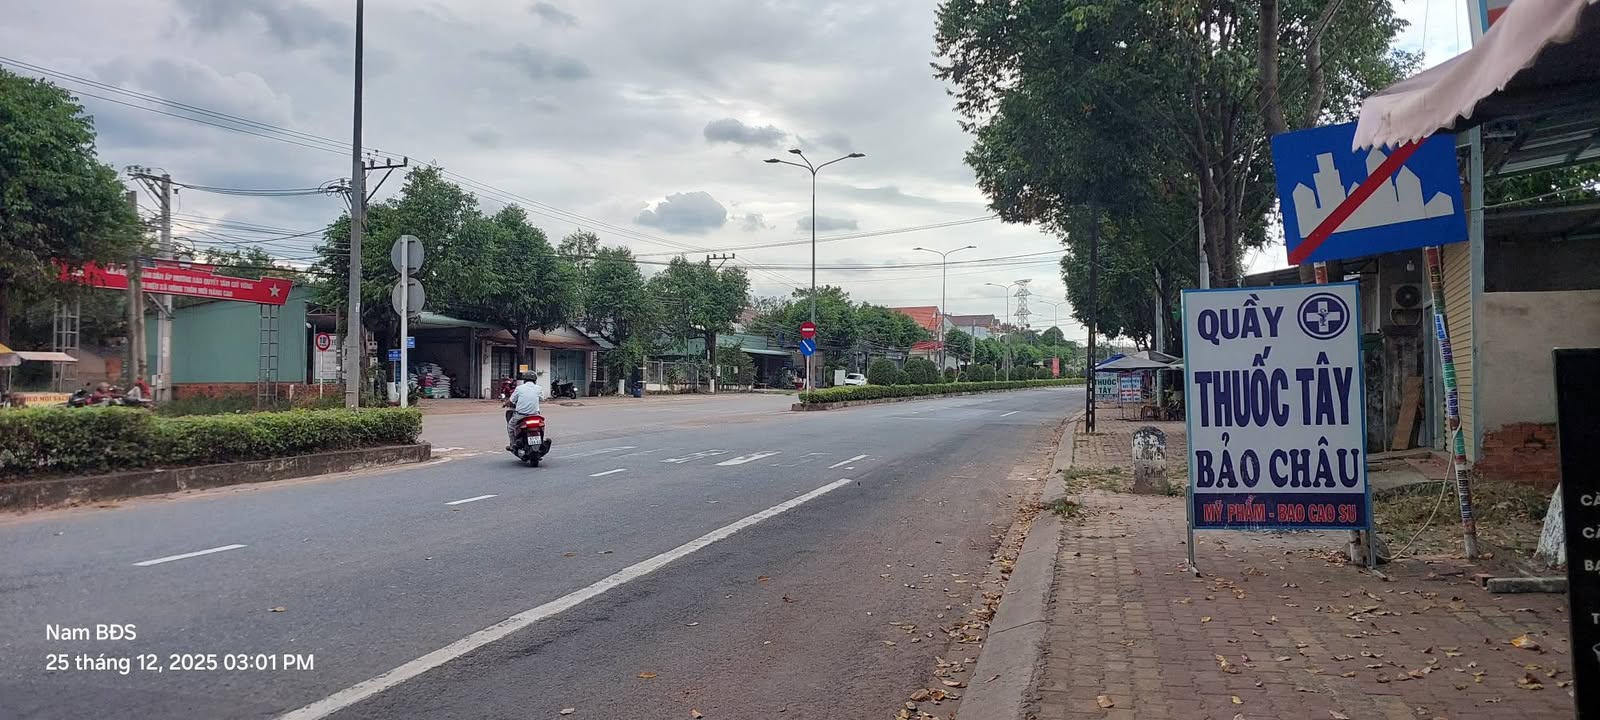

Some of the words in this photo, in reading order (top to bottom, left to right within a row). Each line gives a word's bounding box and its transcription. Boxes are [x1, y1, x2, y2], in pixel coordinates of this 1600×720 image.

[1197, 294, 1284, 346] QUẦY
[1194, 346, 1290, 427] THUỐC
[1295, 351, 1353, 426] TÂY
[1195, 432, 1261, 488] BẢO
[1268, 436, 1359, 489] CHÂU
[1203, 500, 1223, 522] MỸ
[1227, 495, 1266, 522] PHẨM
[1277, 503, 1305, 523] BAO
[1308, 503, 1336, 523] CAO
[1338, 503, 1357, 523] SU
